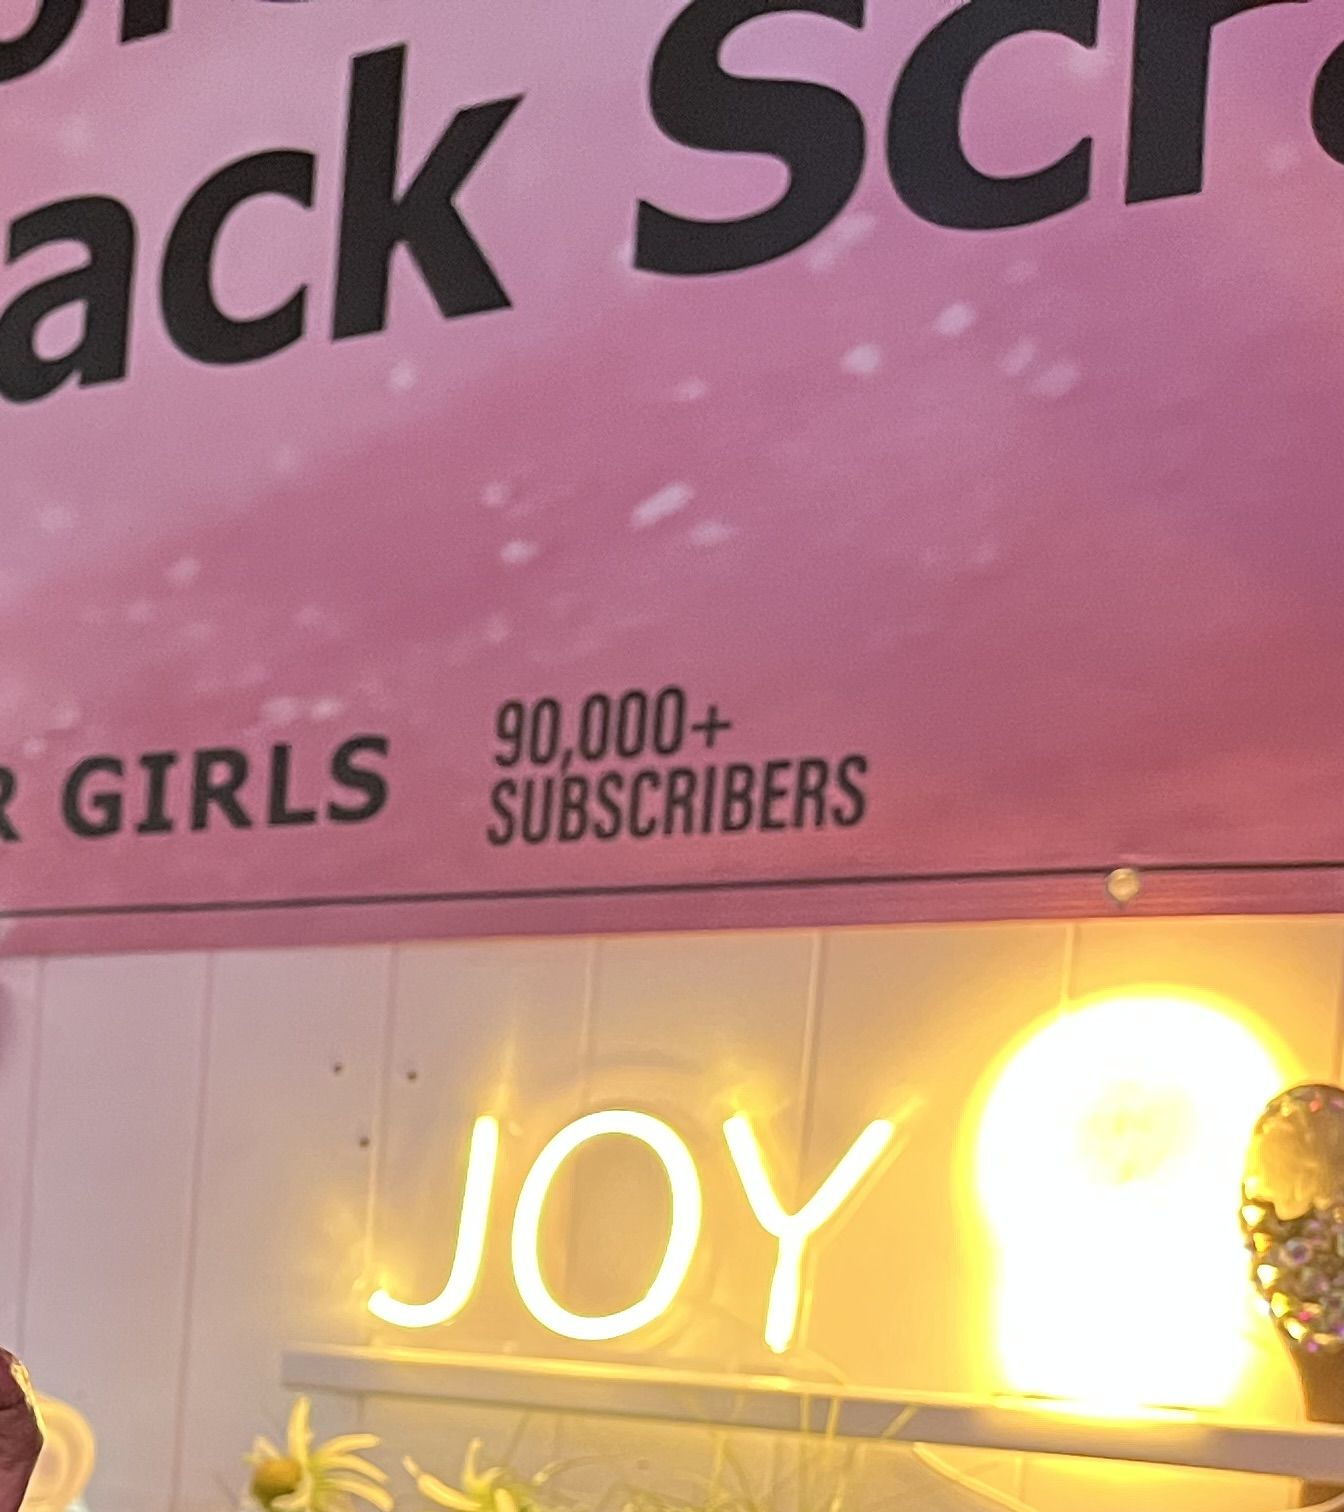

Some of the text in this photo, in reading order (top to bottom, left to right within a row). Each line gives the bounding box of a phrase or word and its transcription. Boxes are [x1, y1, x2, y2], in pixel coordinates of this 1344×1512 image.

[633, 0, 1344, 277] Scr
[494, 684, 733, 775] 90,000+
[60, 734, 392, 839] GIRLS
[487, 752, 869, 847] SUBSCRIBERS
[366, 1106, 895, 1355] JOY
